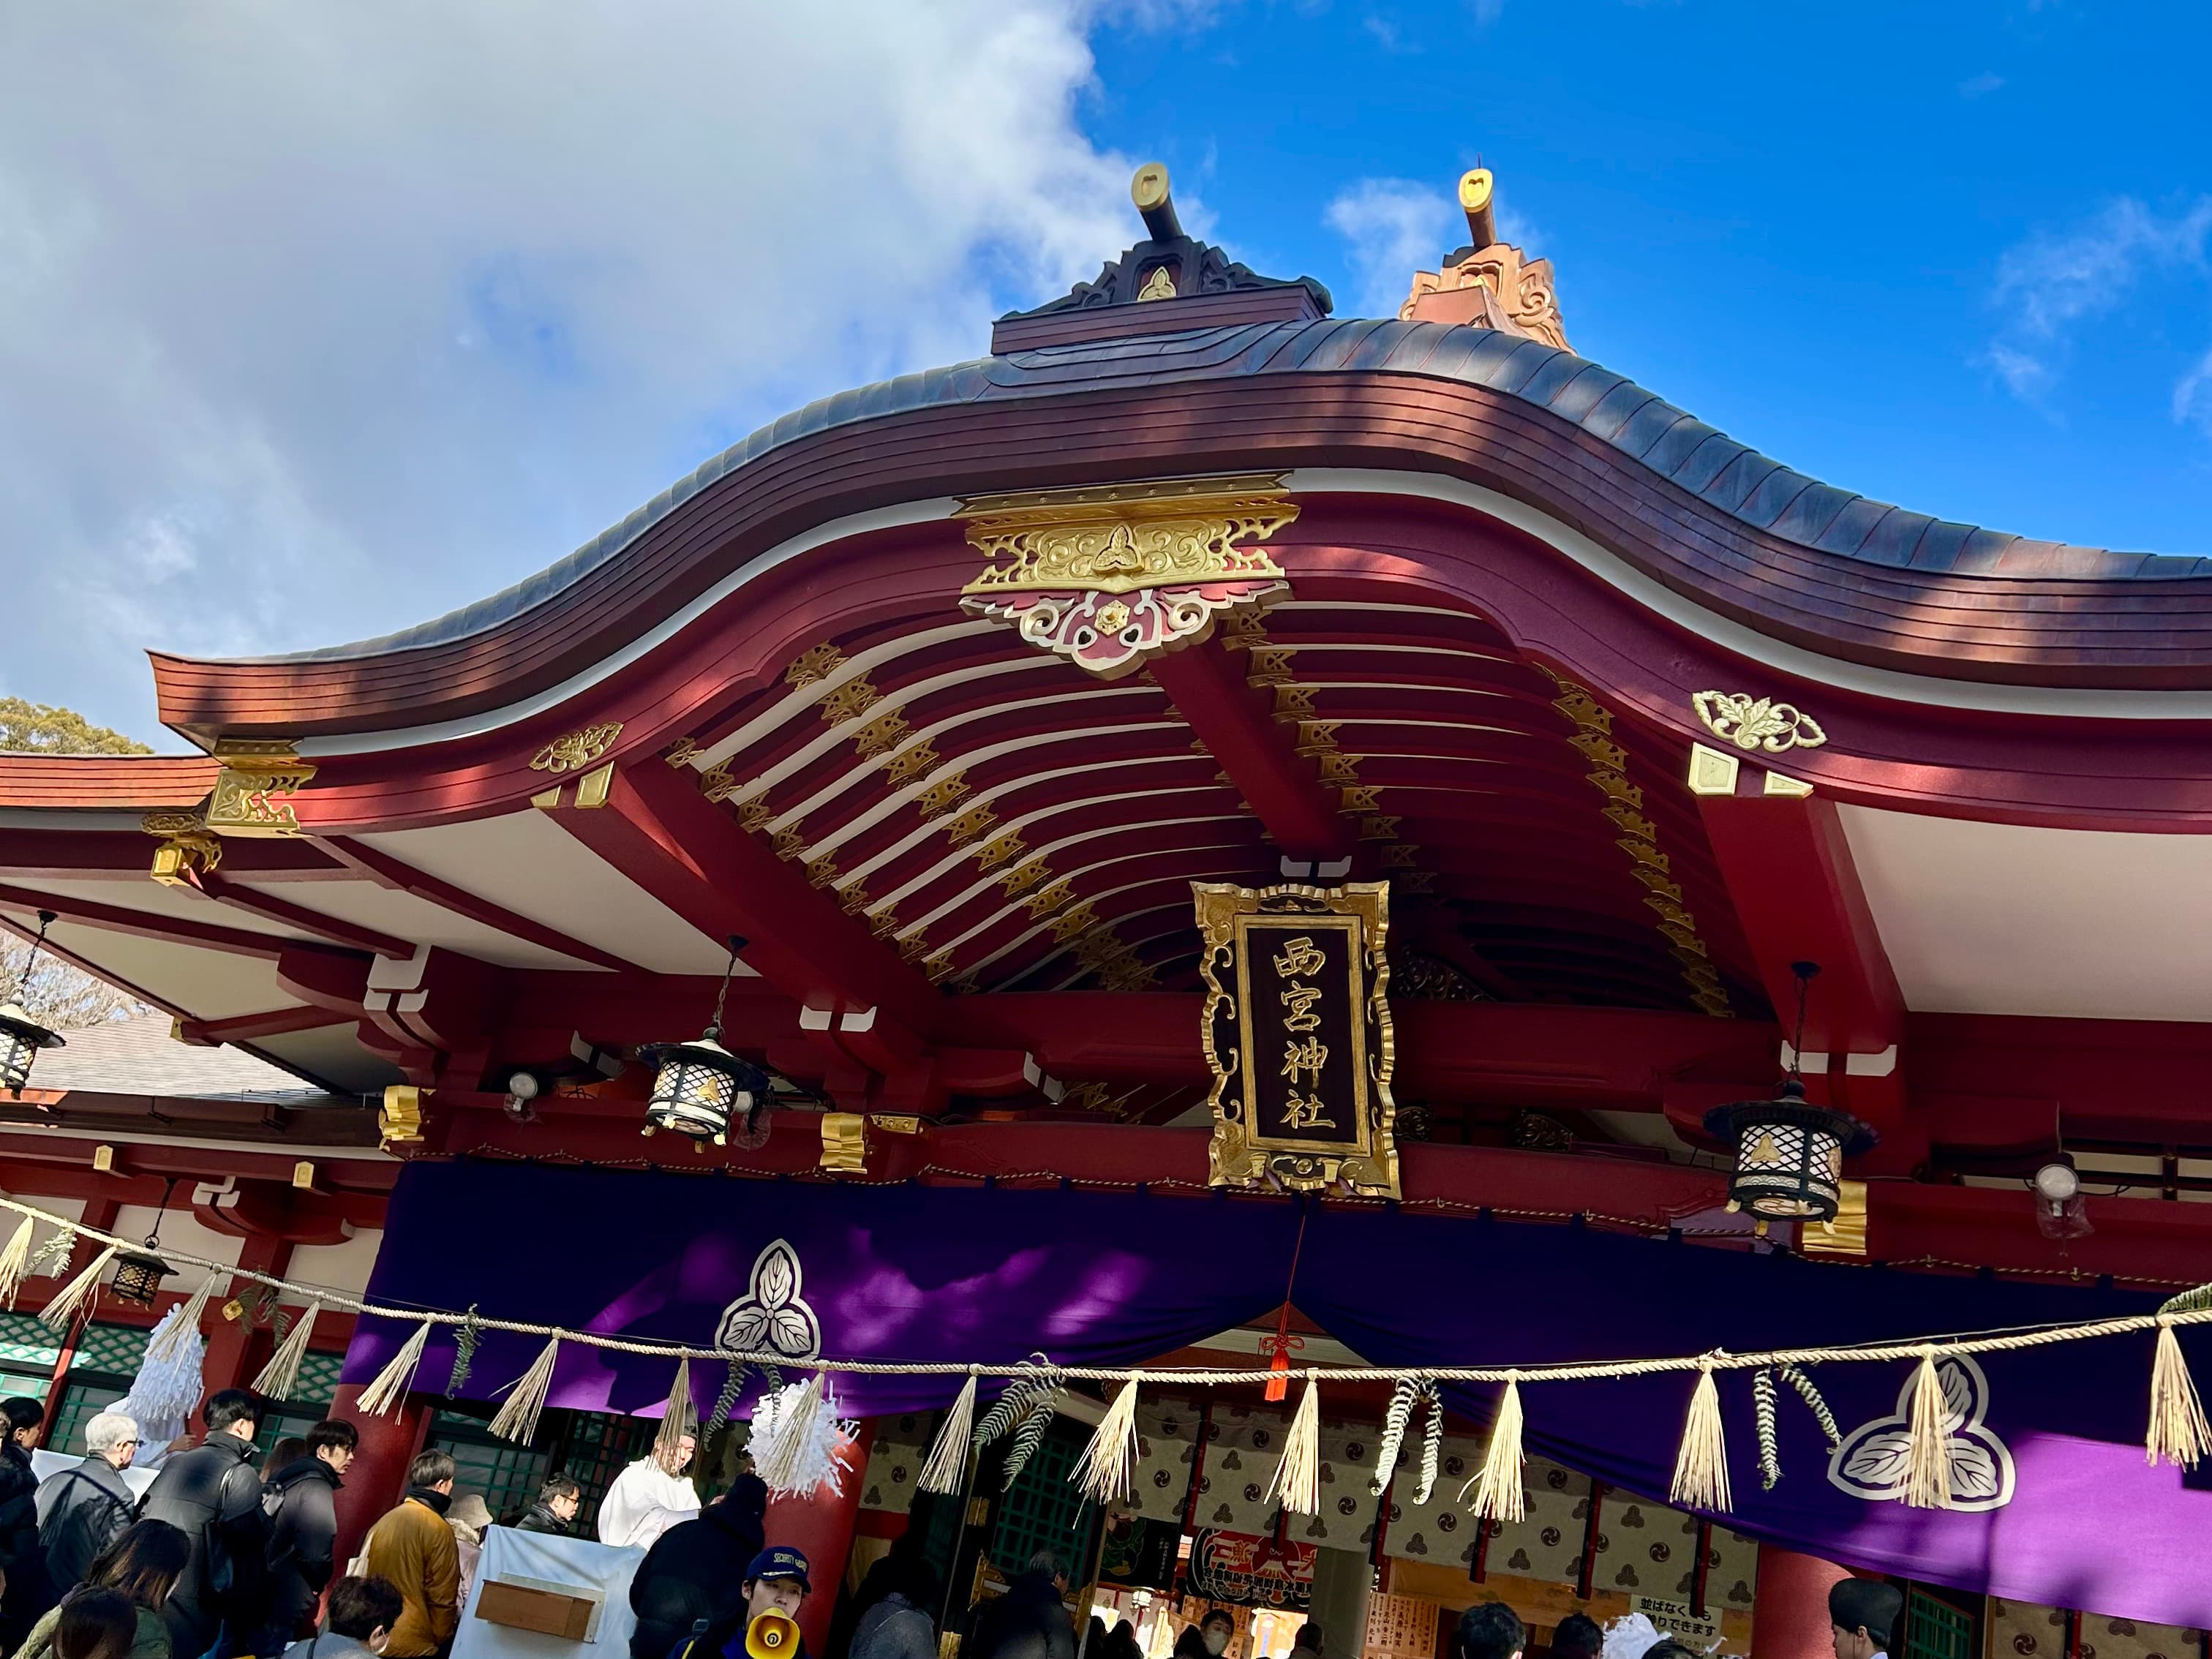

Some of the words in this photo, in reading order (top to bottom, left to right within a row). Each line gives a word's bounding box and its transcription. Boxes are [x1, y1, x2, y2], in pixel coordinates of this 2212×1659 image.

[1273, 936, 1336, 1129] 西宮神社
[1639, 1598, 1711, 1621] 並ばなくも
